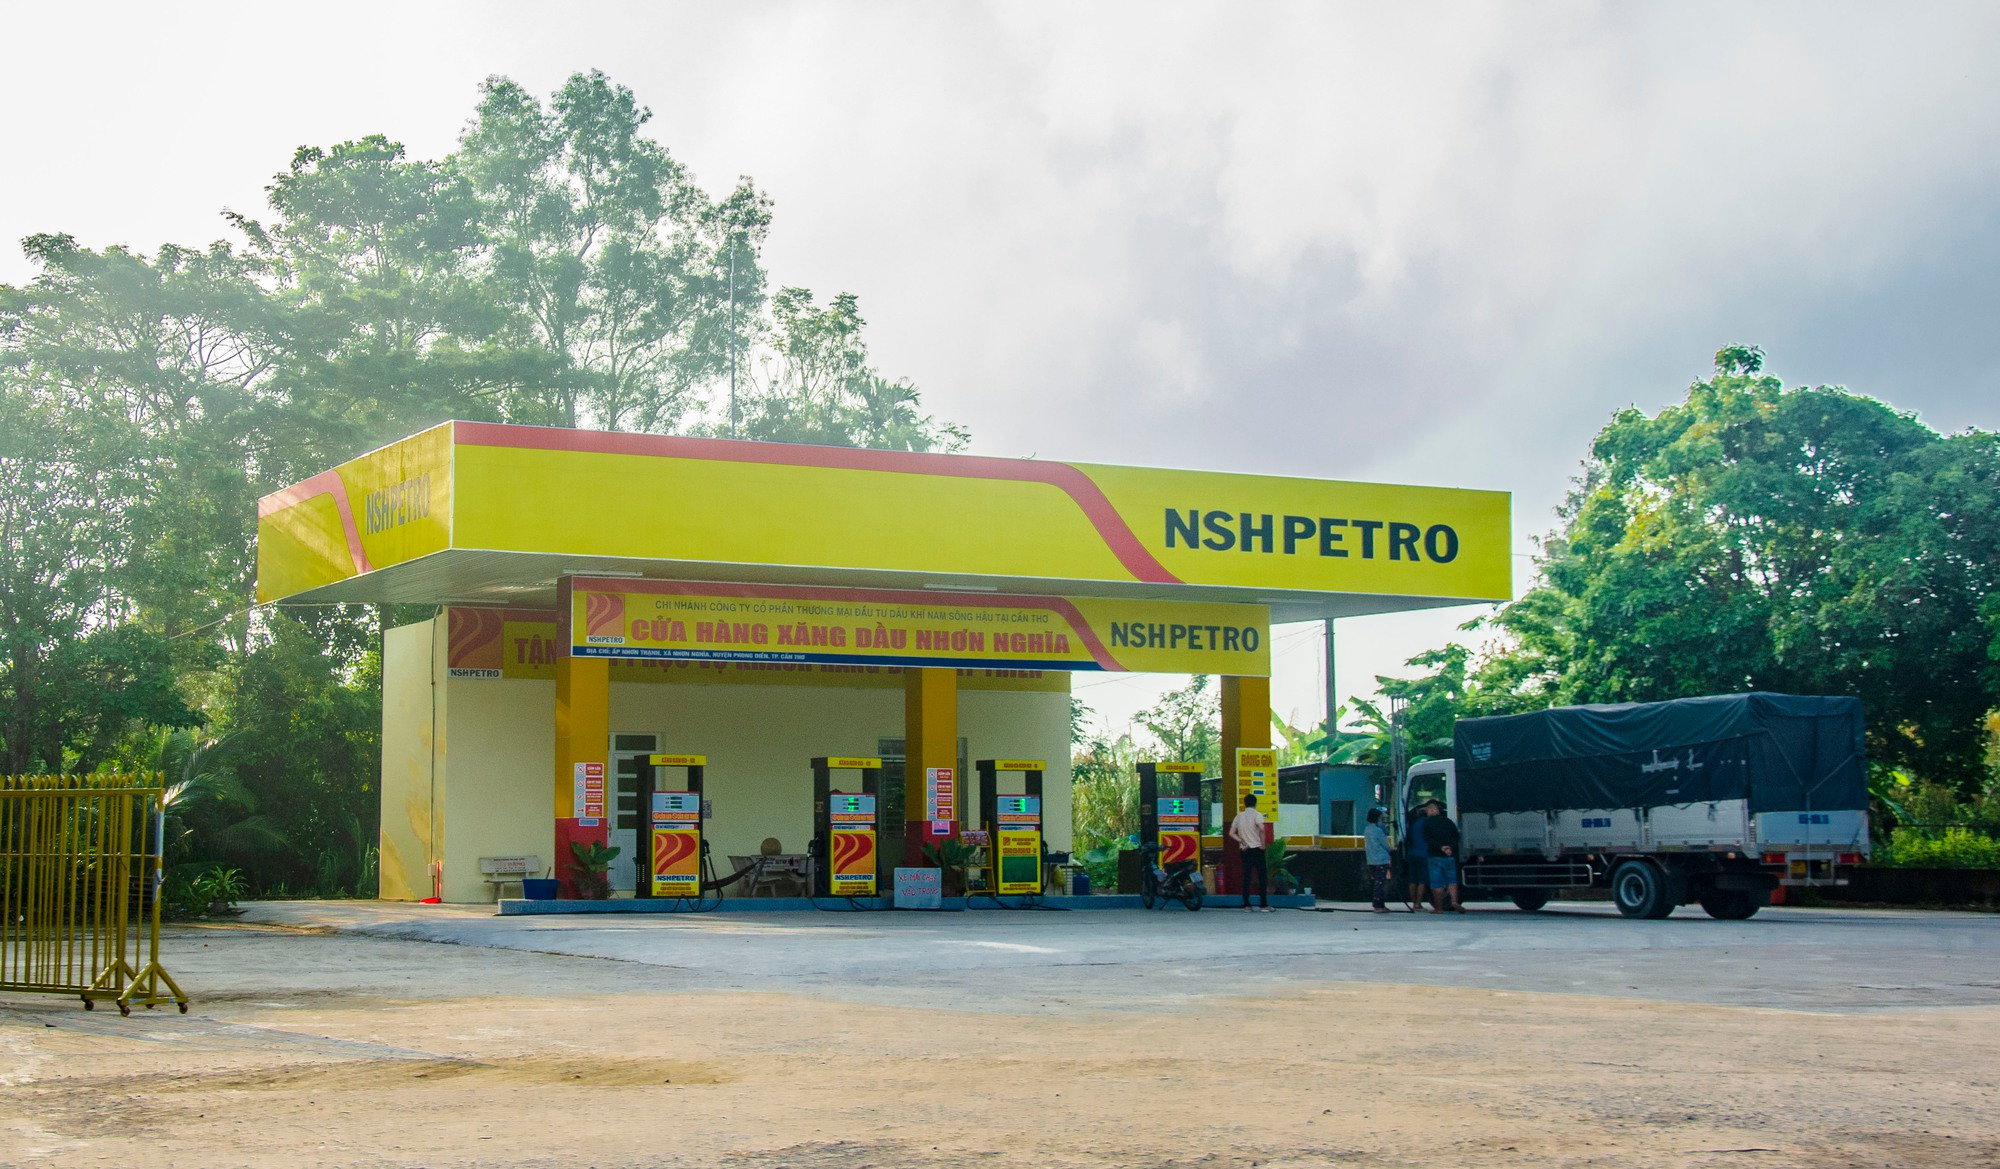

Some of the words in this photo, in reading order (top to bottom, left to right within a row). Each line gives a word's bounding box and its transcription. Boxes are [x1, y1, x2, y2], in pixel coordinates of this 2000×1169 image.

[365, 472, 431, 536] NSHPETRO
[1165, 507, 1458, 563] NSHPETRO
[655, 600, 672, 609] CHI
[674, 599, 707, 611] NHÁNH
[709, 601, 737, 611] CÔNG
[739, 603, 750, 611] TY
[753, 600, 766, 612] CỔ
[768, 602, 794, 613] PHẦN
[796, 604, 834, 615] THƯƠNG
[836, 607, 853, 617] MẠI
[855, 605, 874, 617] ĐẦU
[876, 607, 888, 617] TƯ
[889, 607, 908, 618] DẦU
[910, 608, 925, 618] KHÍ
[927, 611, 946, 619] NAM
[948, 610, 973, 621] SÔNG
[975, 611, 993, 622] HẬU
[996, 614, 1009, 624] TẠI
[1010, 612, 1029, 623] CẦN
[1031, 614, 1049, 623] THƠ
[631, 615, 687, 642] CỬA
[695, 619, 768, 645] HÀNG
[776, 622, 846, 648] XĂNG
[855, 622, 907, 650] DẦU
[915, 628, 984, 652] NHƠN
[992, 630, 1070, 654] NGHĨA
[1111, 622, 1259, 653] NSHPETRO
[451, 669, 500, 677] NSHPETRO
